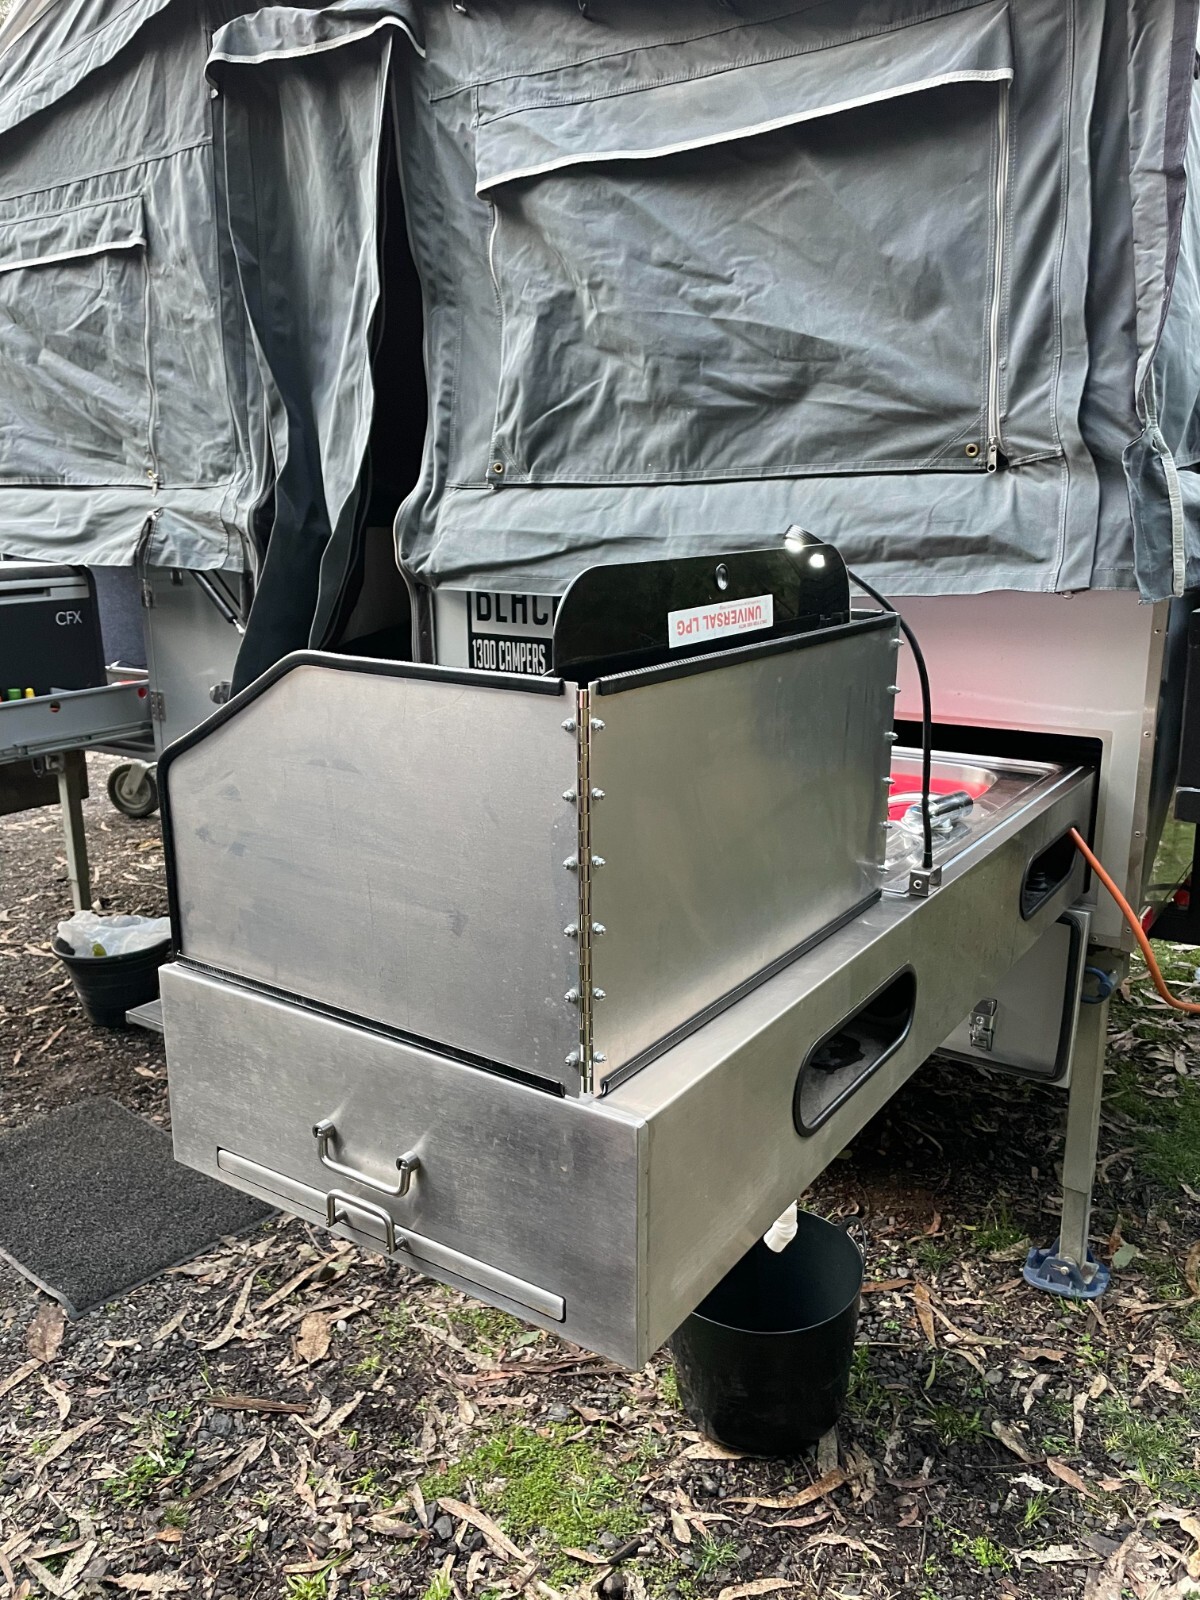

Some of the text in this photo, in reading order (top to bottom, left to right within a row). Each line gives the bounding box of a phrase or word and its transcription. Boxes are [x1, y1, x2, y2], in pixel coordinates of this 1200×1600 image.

[55, 610, 82, 625] CFX
[676, 617, 700, 636] LPG
[703, 605, 762, 630] UNIVERSAL
[472, 639, 546, 674] 1300 CAMPERS
